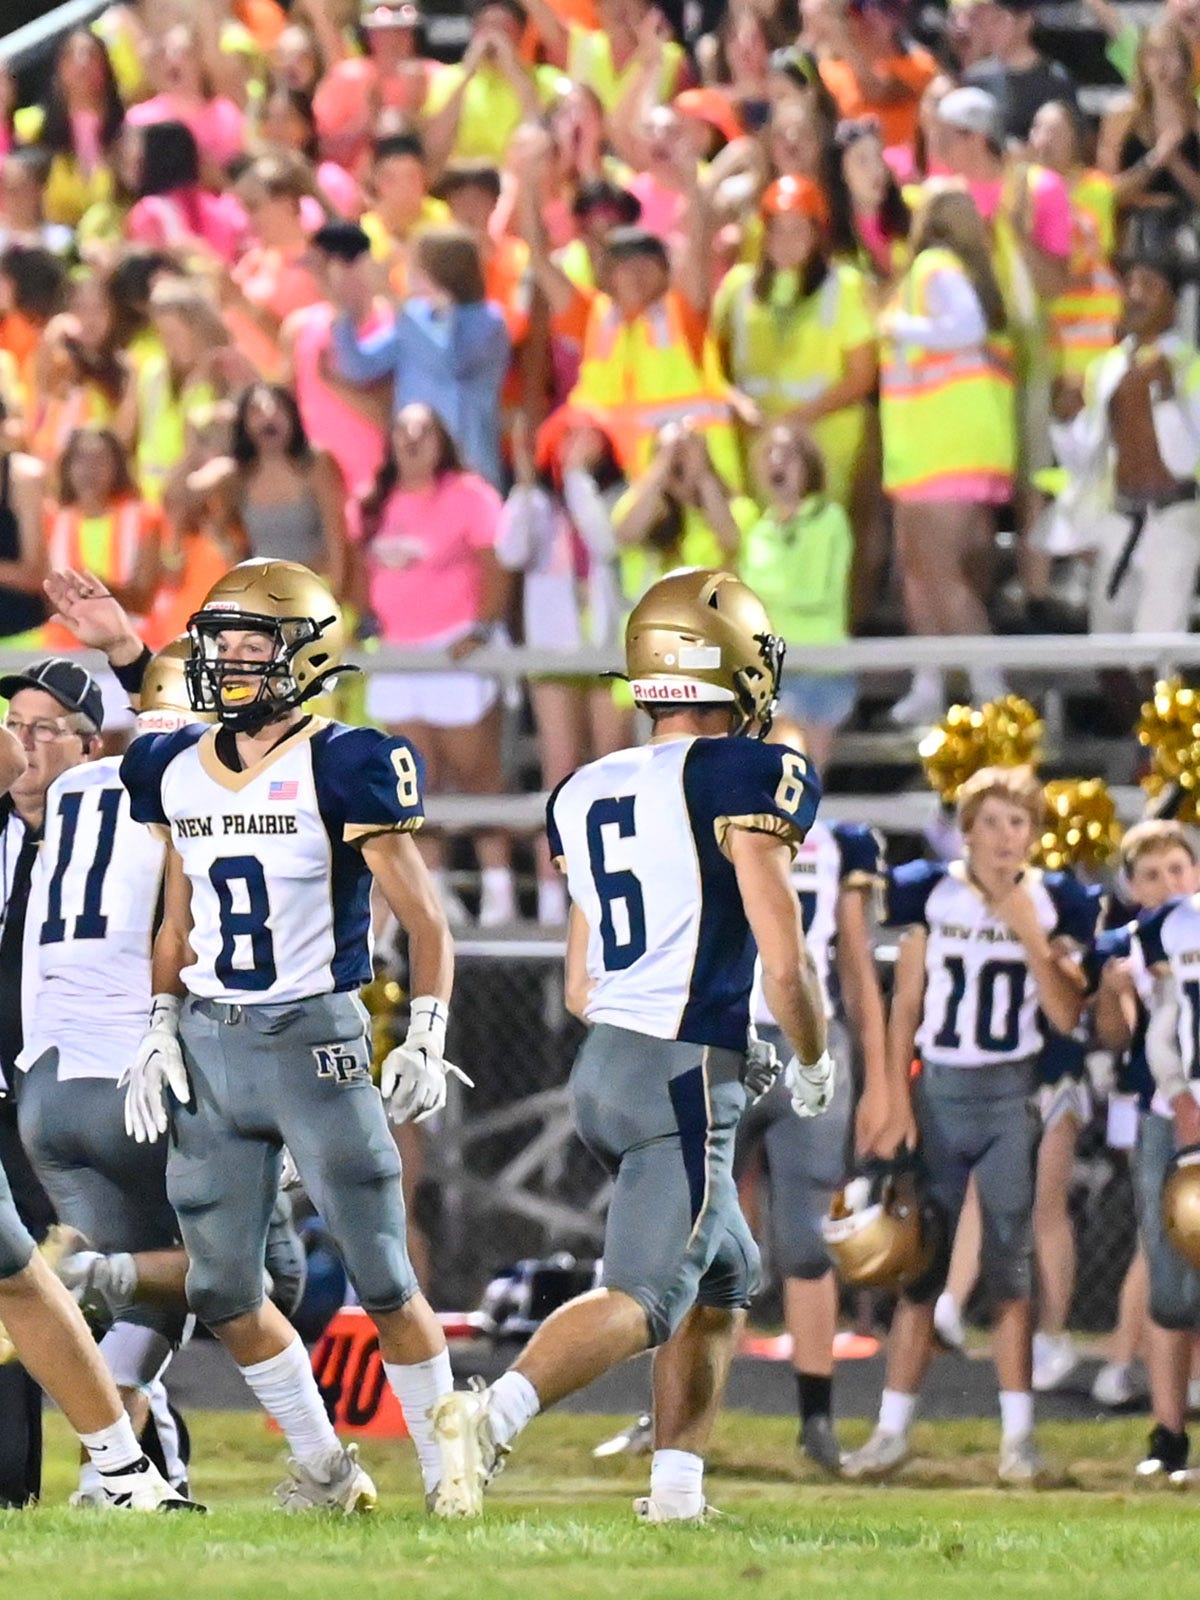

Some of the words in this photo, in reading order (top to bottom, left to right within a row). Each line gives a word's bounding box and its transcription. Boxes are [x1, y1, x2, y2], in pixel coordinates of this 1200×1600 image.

[633, 683, 698, 699] Riddell
[390, 746, 420, 807] 8
[774, 752, 807, 815] 6
[173, 817, 214, 838] NEW
[223, 813, 299, 835] PRAIRIE
[39, 788, 124, 945] 11
[586, 794, 647, 972] 6
[208, 854, 278, 991] 8
[933, 956, 1029, 1052] 10
